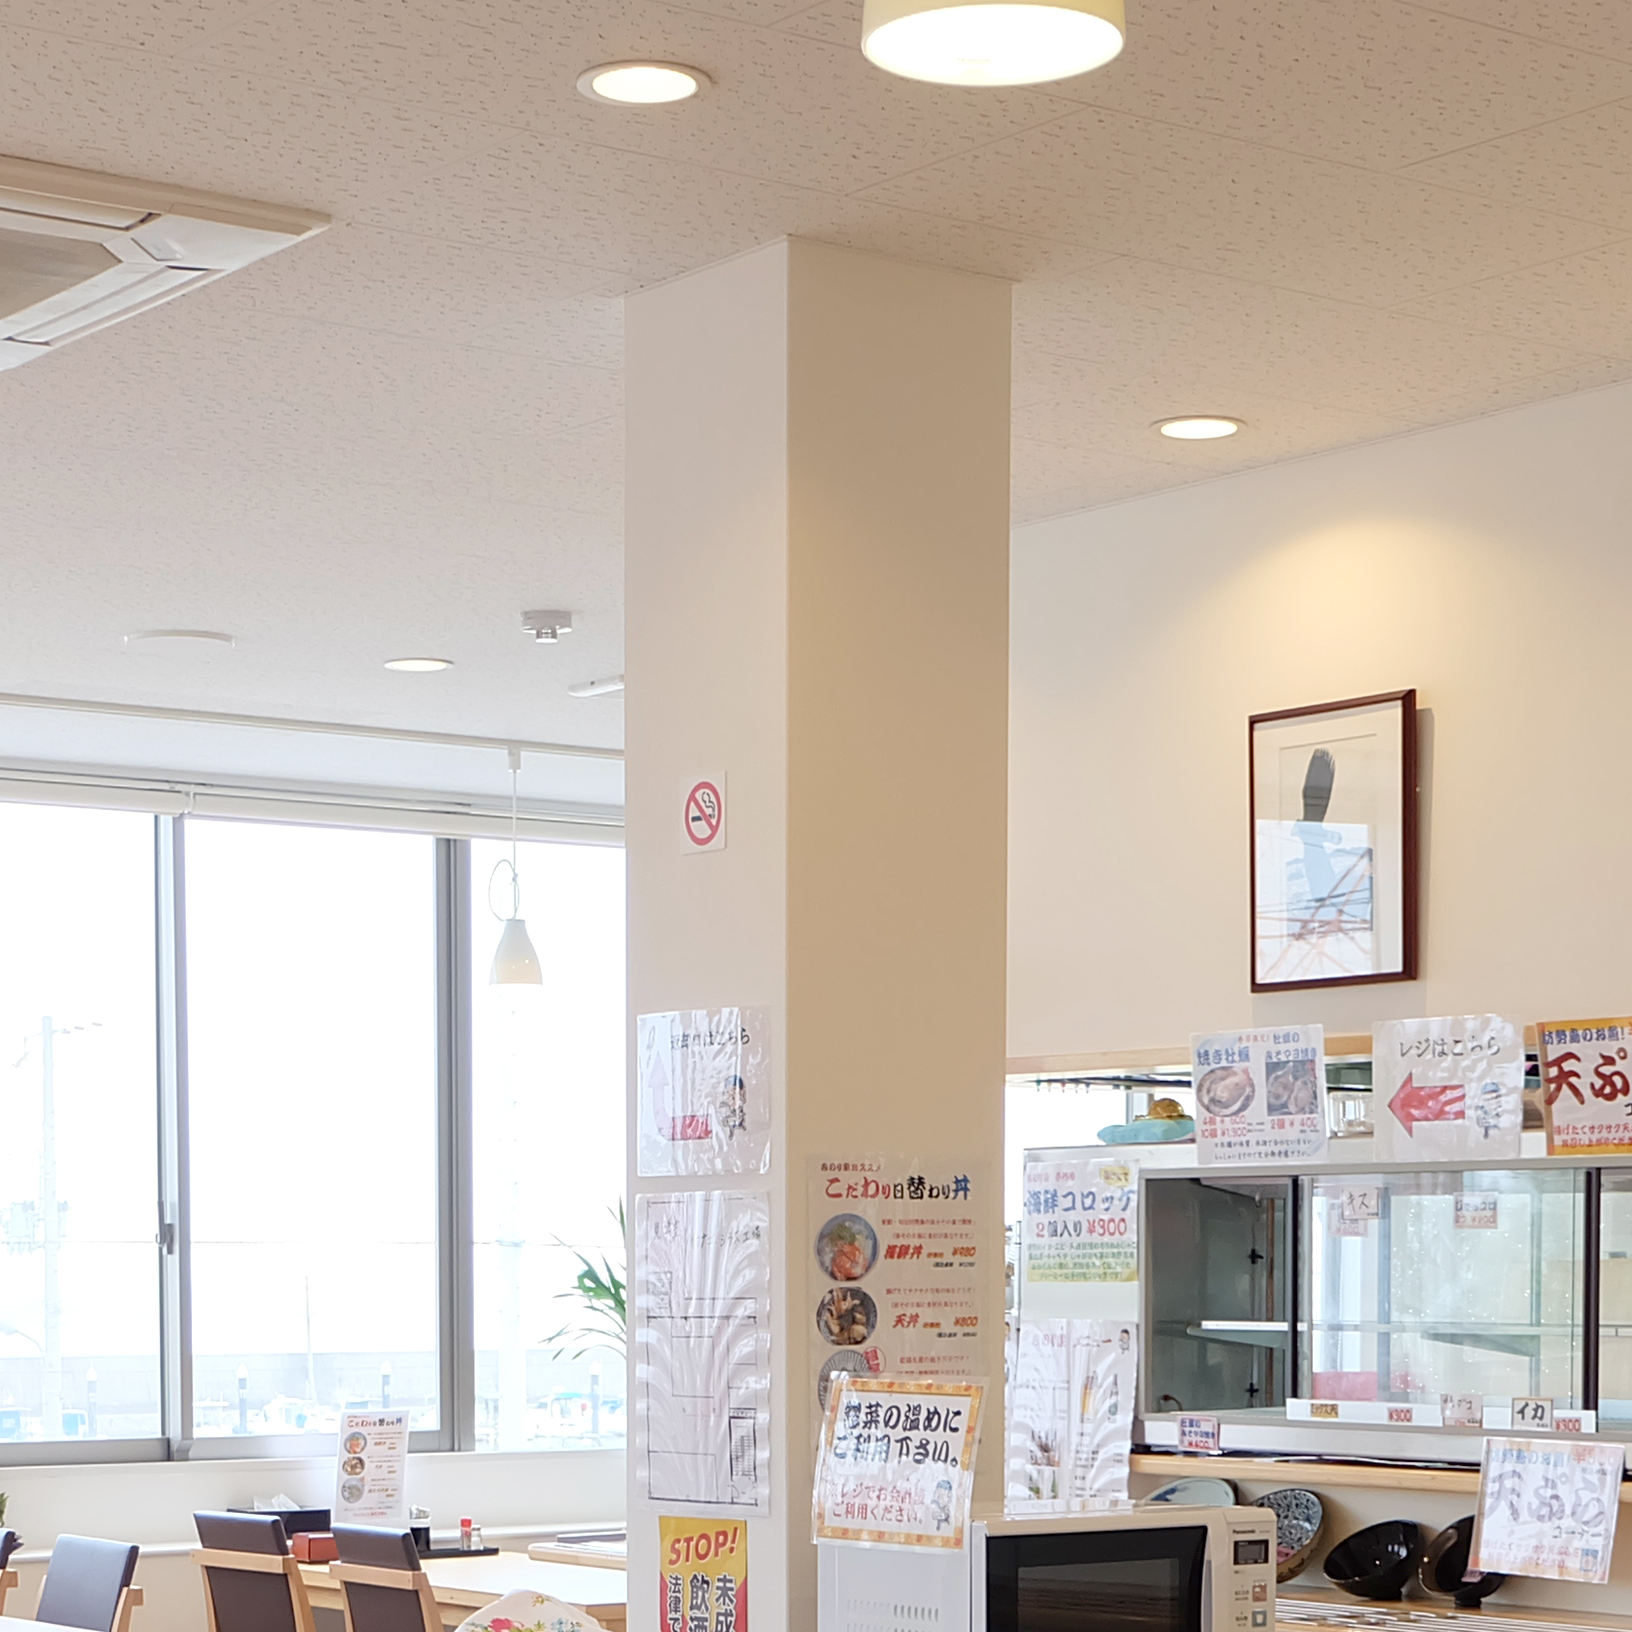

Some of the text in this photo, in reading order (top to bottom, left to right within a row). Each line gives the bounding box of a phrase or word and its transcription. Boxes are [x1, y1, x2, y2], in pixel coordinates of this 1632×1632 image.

[1399, 1035, 1500, 1058] レジはこちら
[825, 1174, 972, 1200] こだわり日替わり丼
[1026, 1188, 1137, 1216] 海鮮コロッケ
[884, 1244, 924, 1260] 海鮮丼
[892, 1312, 920, 1329] 天丼
[1517, 1401, 1546, 1422] イカ
[833, 1430, 959, 1467] ご利用下さい。
[1484, 1469, 1606, 1528] 天ぷら
[832, 1500, 924, 1525] ご利用ください。
[667, 1526, 740, 1566] STOP!
[1552, 1525, 1603, 1542] コーナー
